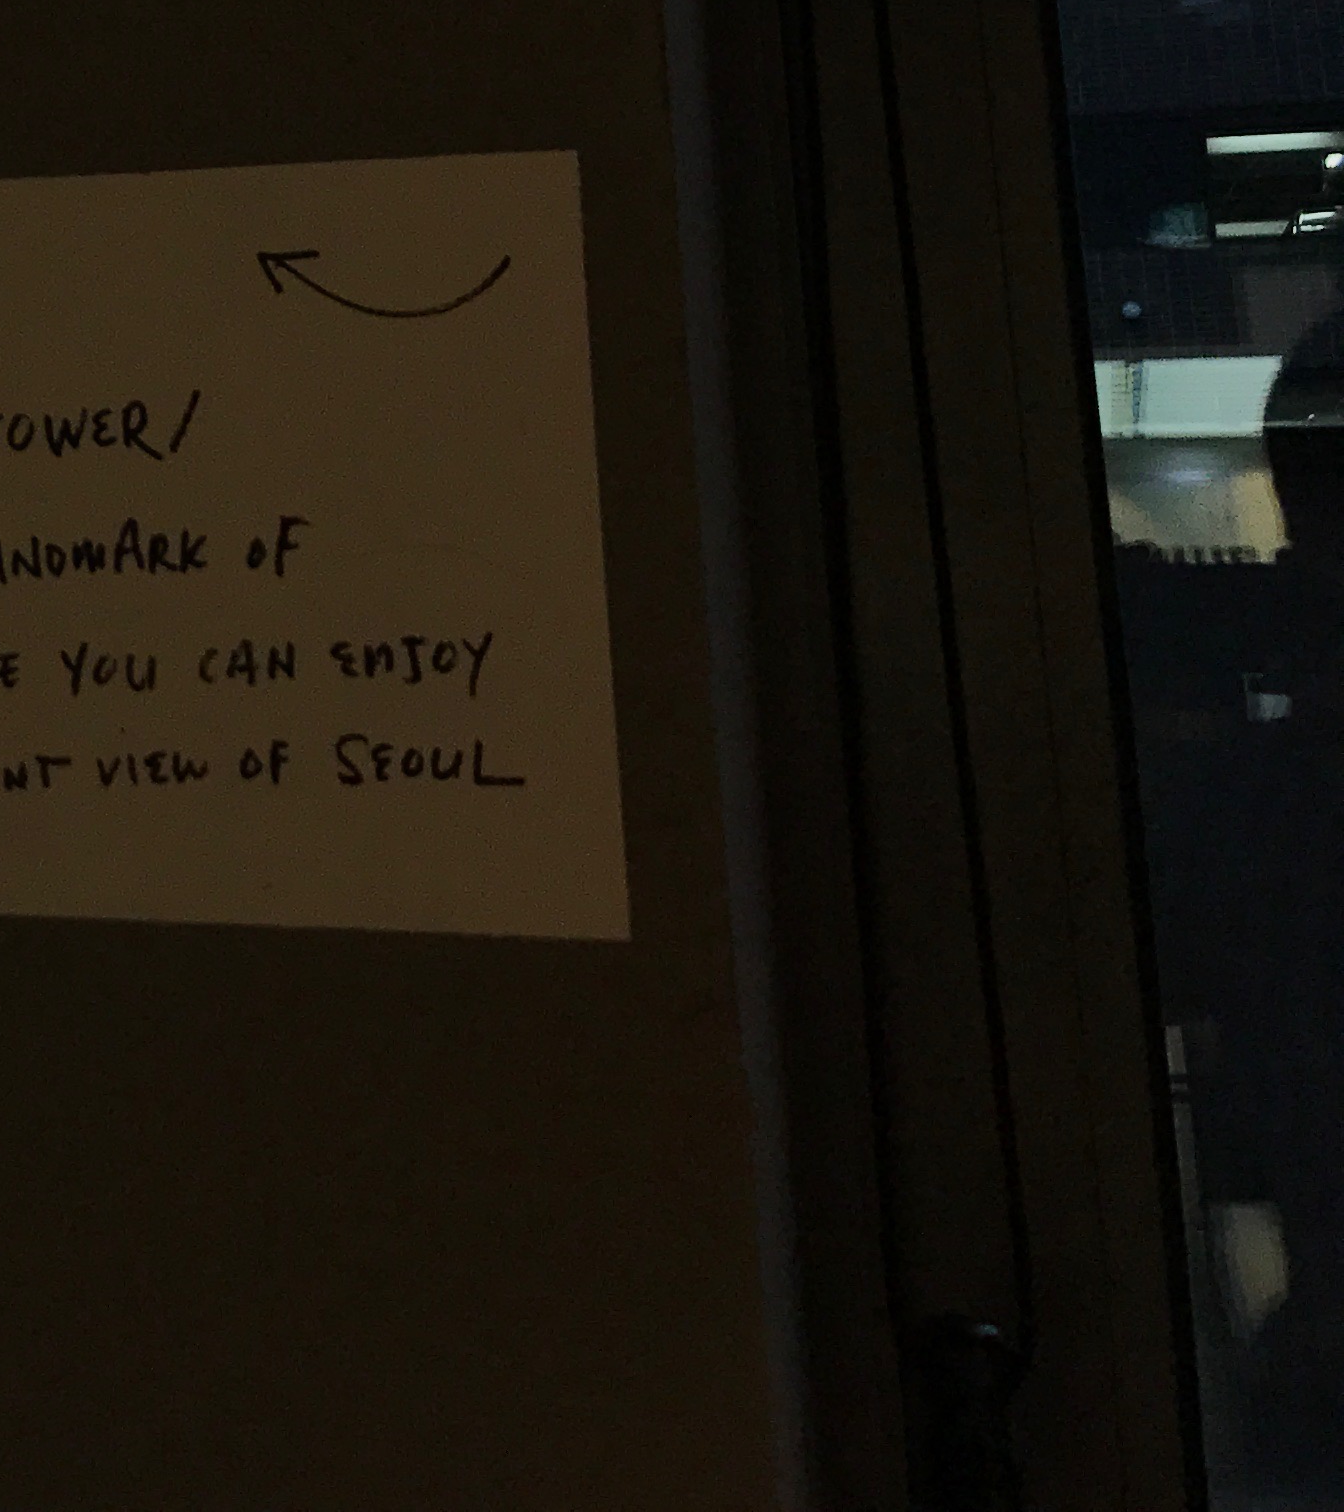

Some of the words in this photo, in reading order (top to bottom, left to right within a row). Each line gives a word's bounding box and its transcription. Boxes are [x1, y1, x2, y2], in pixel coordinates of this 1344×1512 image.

[245, 514, 311, 577] OF
[59, 642, 157, 698] YOU
[197, 638, 296, 687] CAN
[328, 631, 494, 697] ENJOY
[95, 750, 210, 789] VIEW
[238, 739, 290, 786] OF
[333, 732, 527, 788] SEOUL
